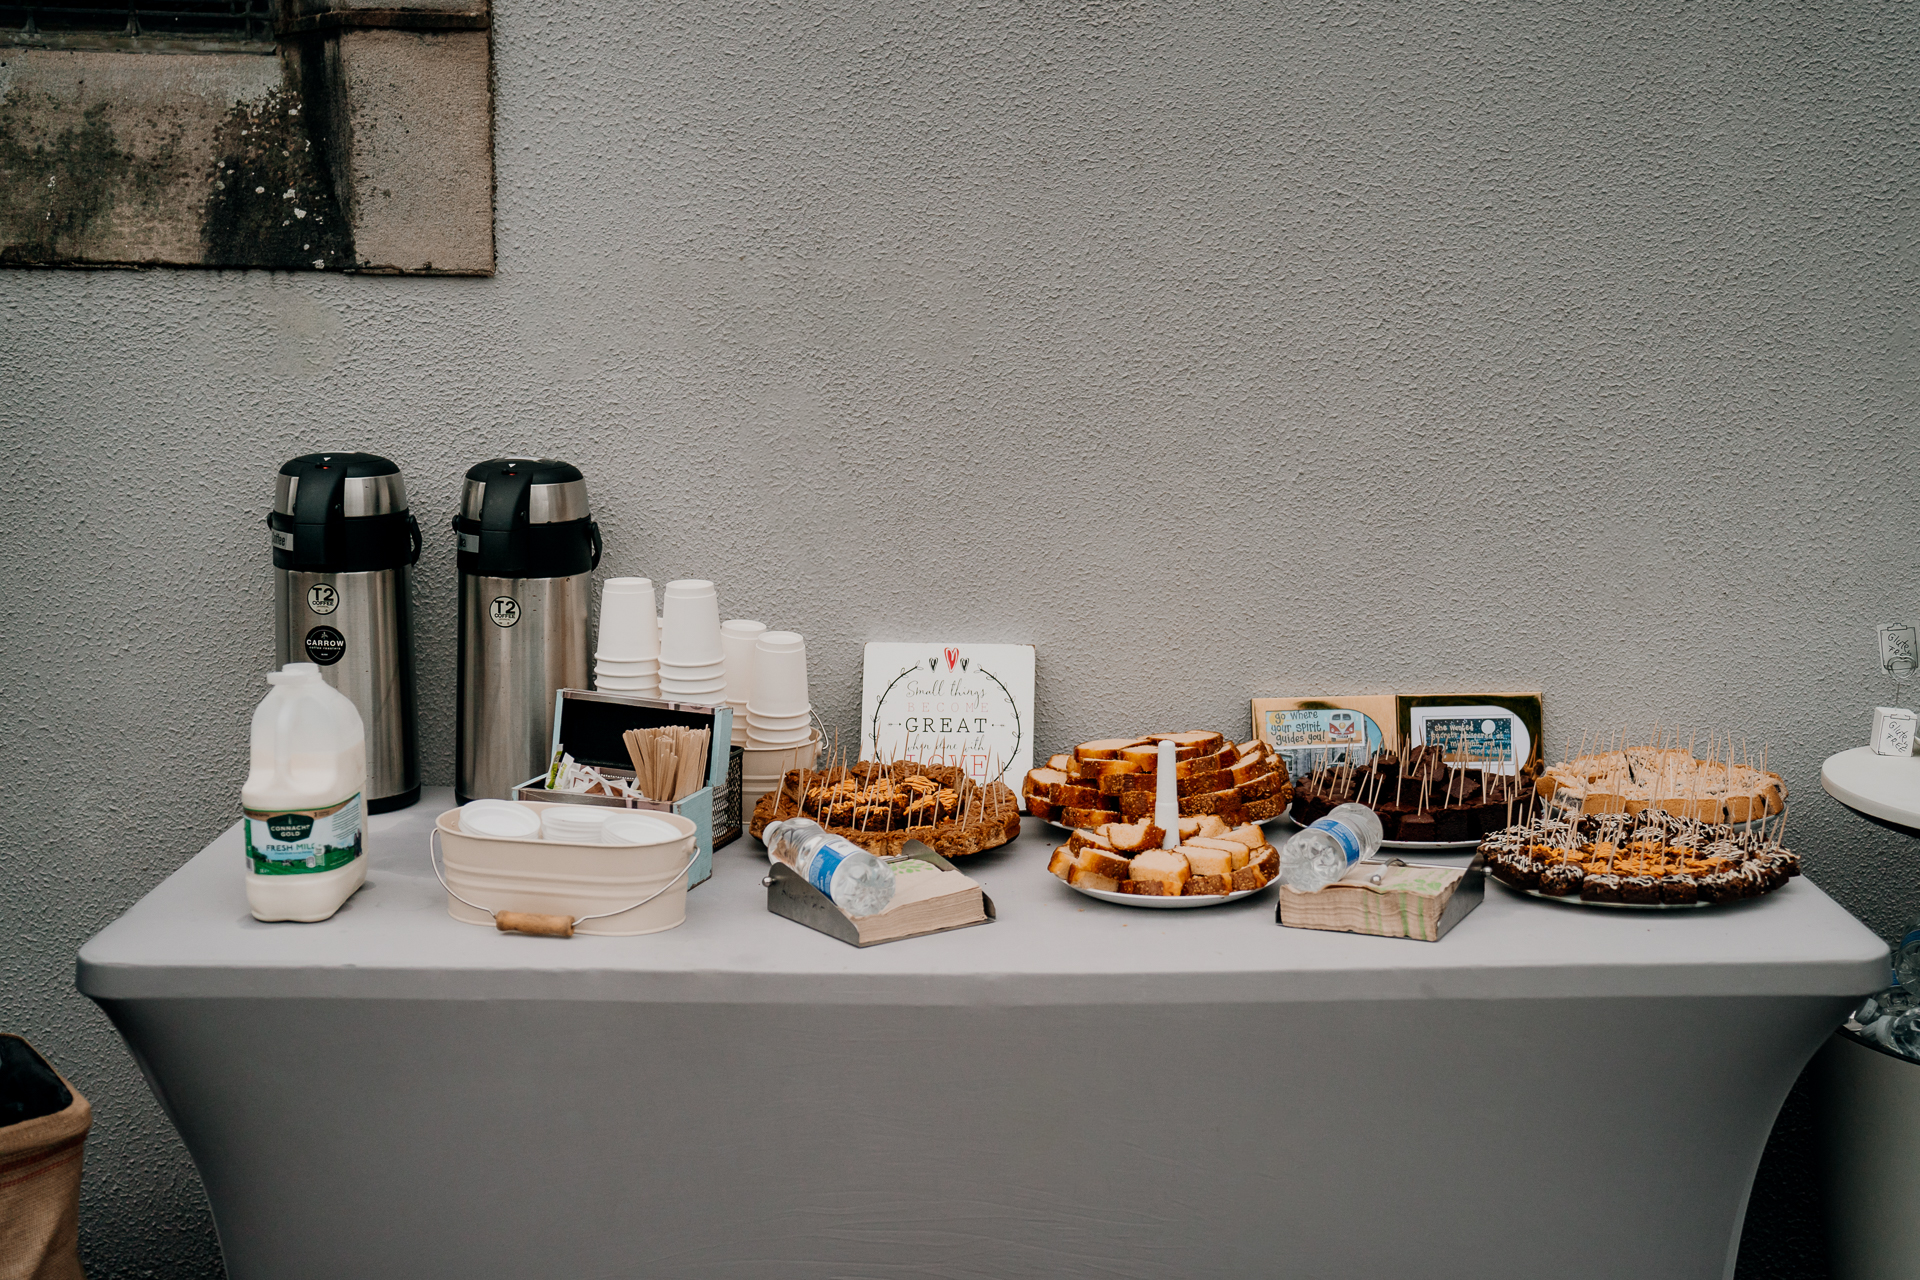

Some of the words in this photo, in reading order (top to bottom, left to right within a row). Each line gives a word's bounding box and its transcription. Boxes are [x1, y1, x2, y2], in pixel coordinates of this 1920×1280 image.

[312, 587, 334, 602] T2
[494, 600, 516, 614] T2
[306, 639, 344, 647] CARROW
[907, 680, 945, 698] Small
[950, 678, 987, 709] things
[907, 702, 989, 713] BECOME
[905, 717, 988, 733] GREAT
[1274, 712, 1286, 724] go
[1270, 724, 1292, 736] your
[1295, 720, 1322, 735] spirit
[1434, 723, 1448, 732] she
[907, 733, 932, 752] when
[935, 734, 958, 750] done
[964, 733, 987, 752] with
[1275, 732, 1305, 746] guides
[1306, 729, 1326, 745] you!
[270, 824, 311, 832] CONNACHT
[266, 844, 293, 852] FRESH
